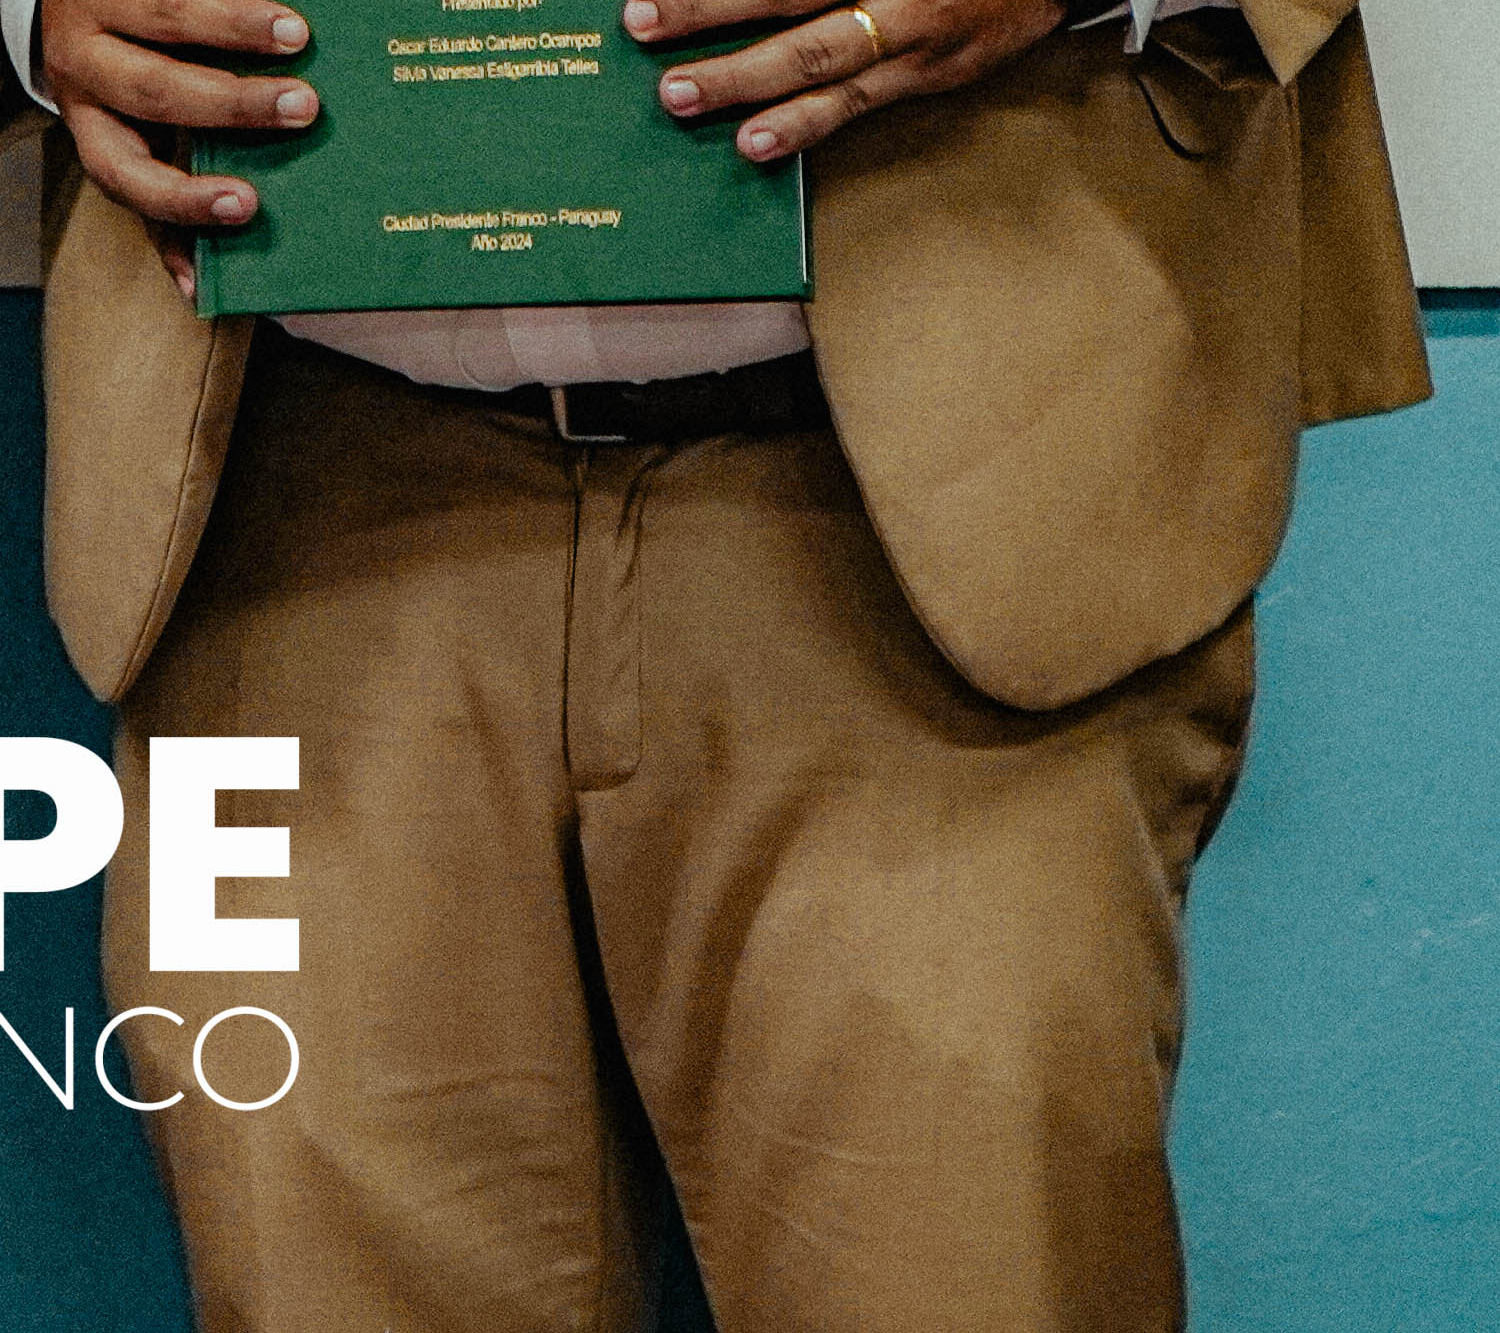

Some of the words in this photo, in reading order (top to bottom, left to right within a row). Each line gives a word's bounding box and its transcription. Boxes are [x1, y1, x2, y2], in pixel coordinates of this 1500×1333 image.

[427, 36, 484, 54] Eduardo
[538, 32, 602, 50] Ocampos
[429, 65, 487, 81] Vanessa
[382, 215, 430, 232] Ciudad
[430, 212, 500, 230] Presidente
[501, 210, 548, 228] Franco
[558, 208, 622, 228] Paraguay
[471, 233, 499, 251] Año
[498, 232, 533, 251] 2024
